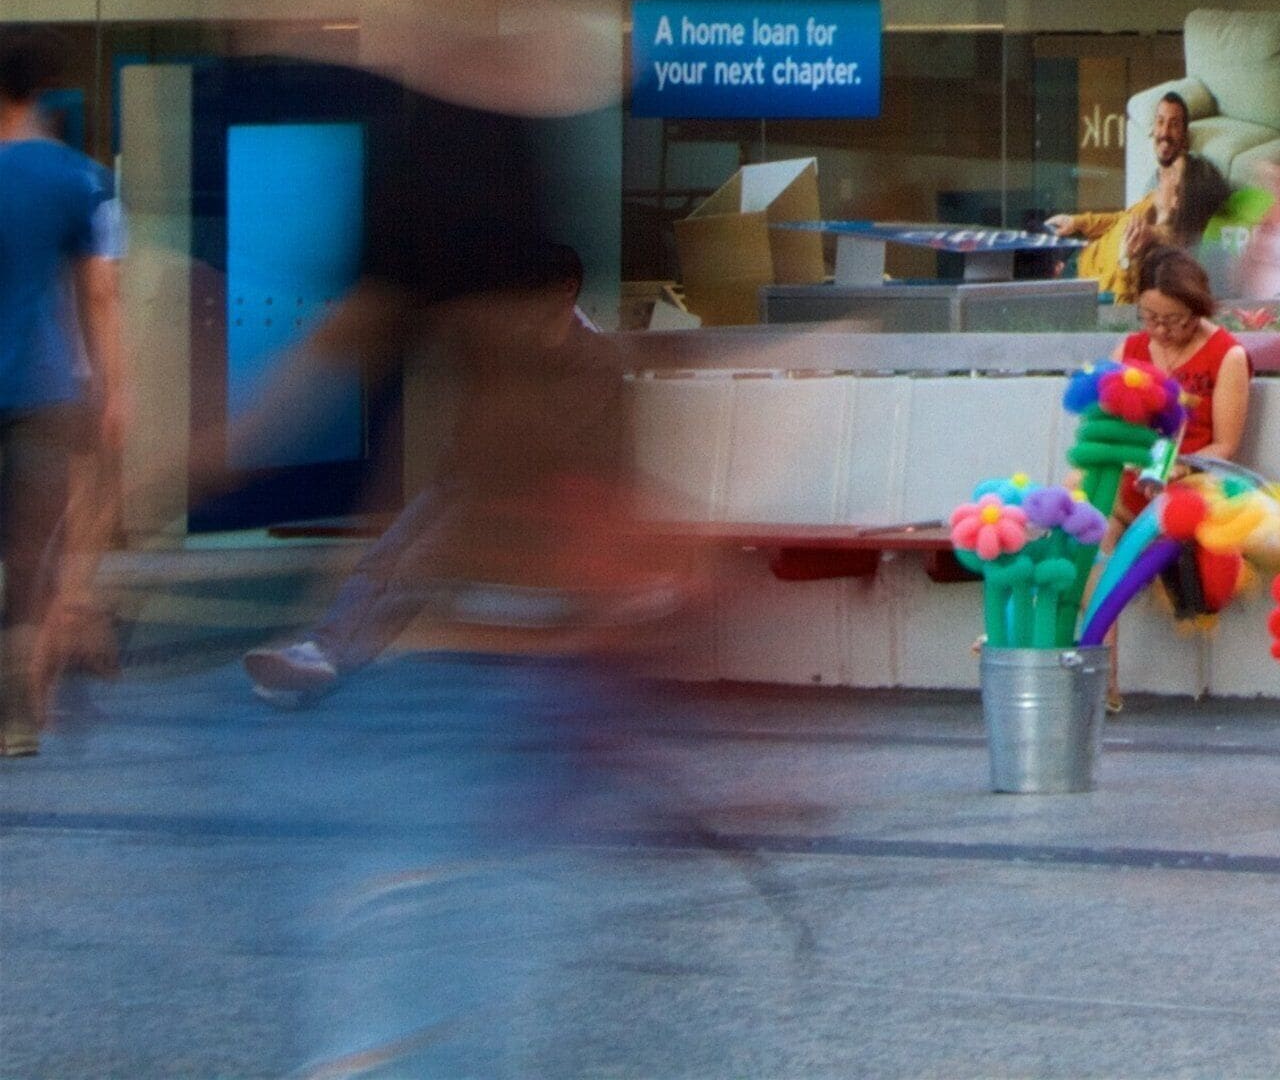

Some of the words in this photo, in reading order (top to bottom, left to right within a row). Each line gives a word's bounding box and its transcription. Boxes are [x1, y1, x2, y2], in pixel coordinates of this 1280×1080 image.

[654, 16, 674, 46] A
[682, 17, 745, 46] home
[752, 17, 800, 46] loan
[806, 17, 838, 46] for
[654, 61, 706, 91] your
[714, 56, 766, 85] next
[772, 56, 862, 92] chapter.
